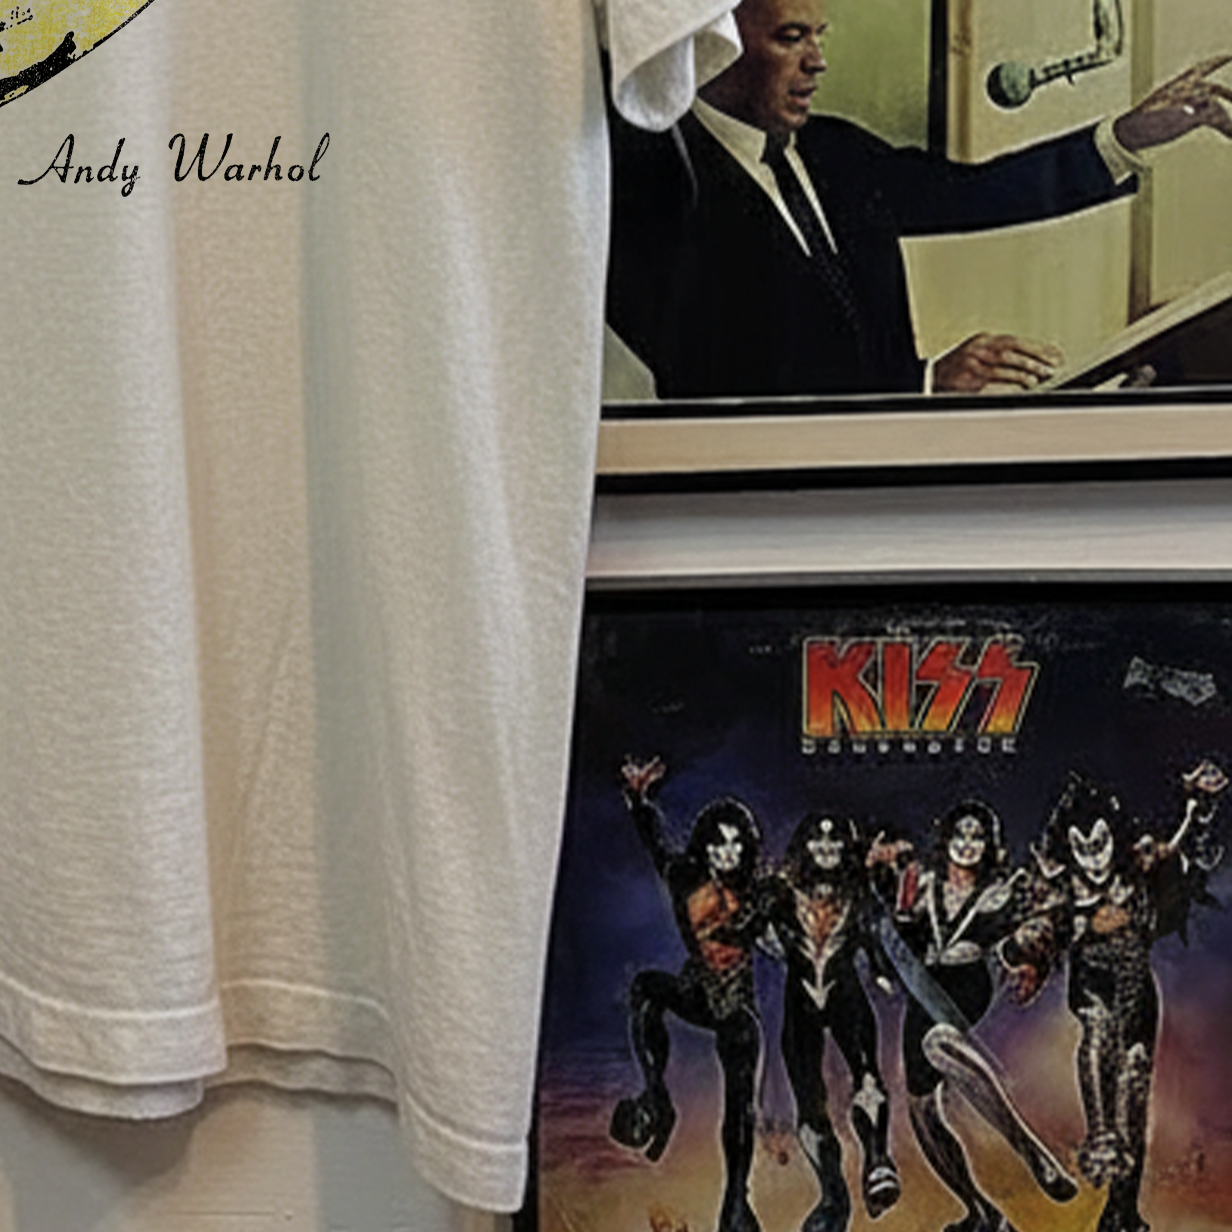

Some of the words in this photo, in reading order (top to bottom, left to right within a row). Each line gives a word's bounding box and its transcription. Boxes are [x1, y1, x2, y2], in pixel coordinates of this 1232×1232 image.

[16, 132, 142, 198] Andy
[168, 131, 331, 183] Warhol
[803, 636, 1041, 740] KISS
